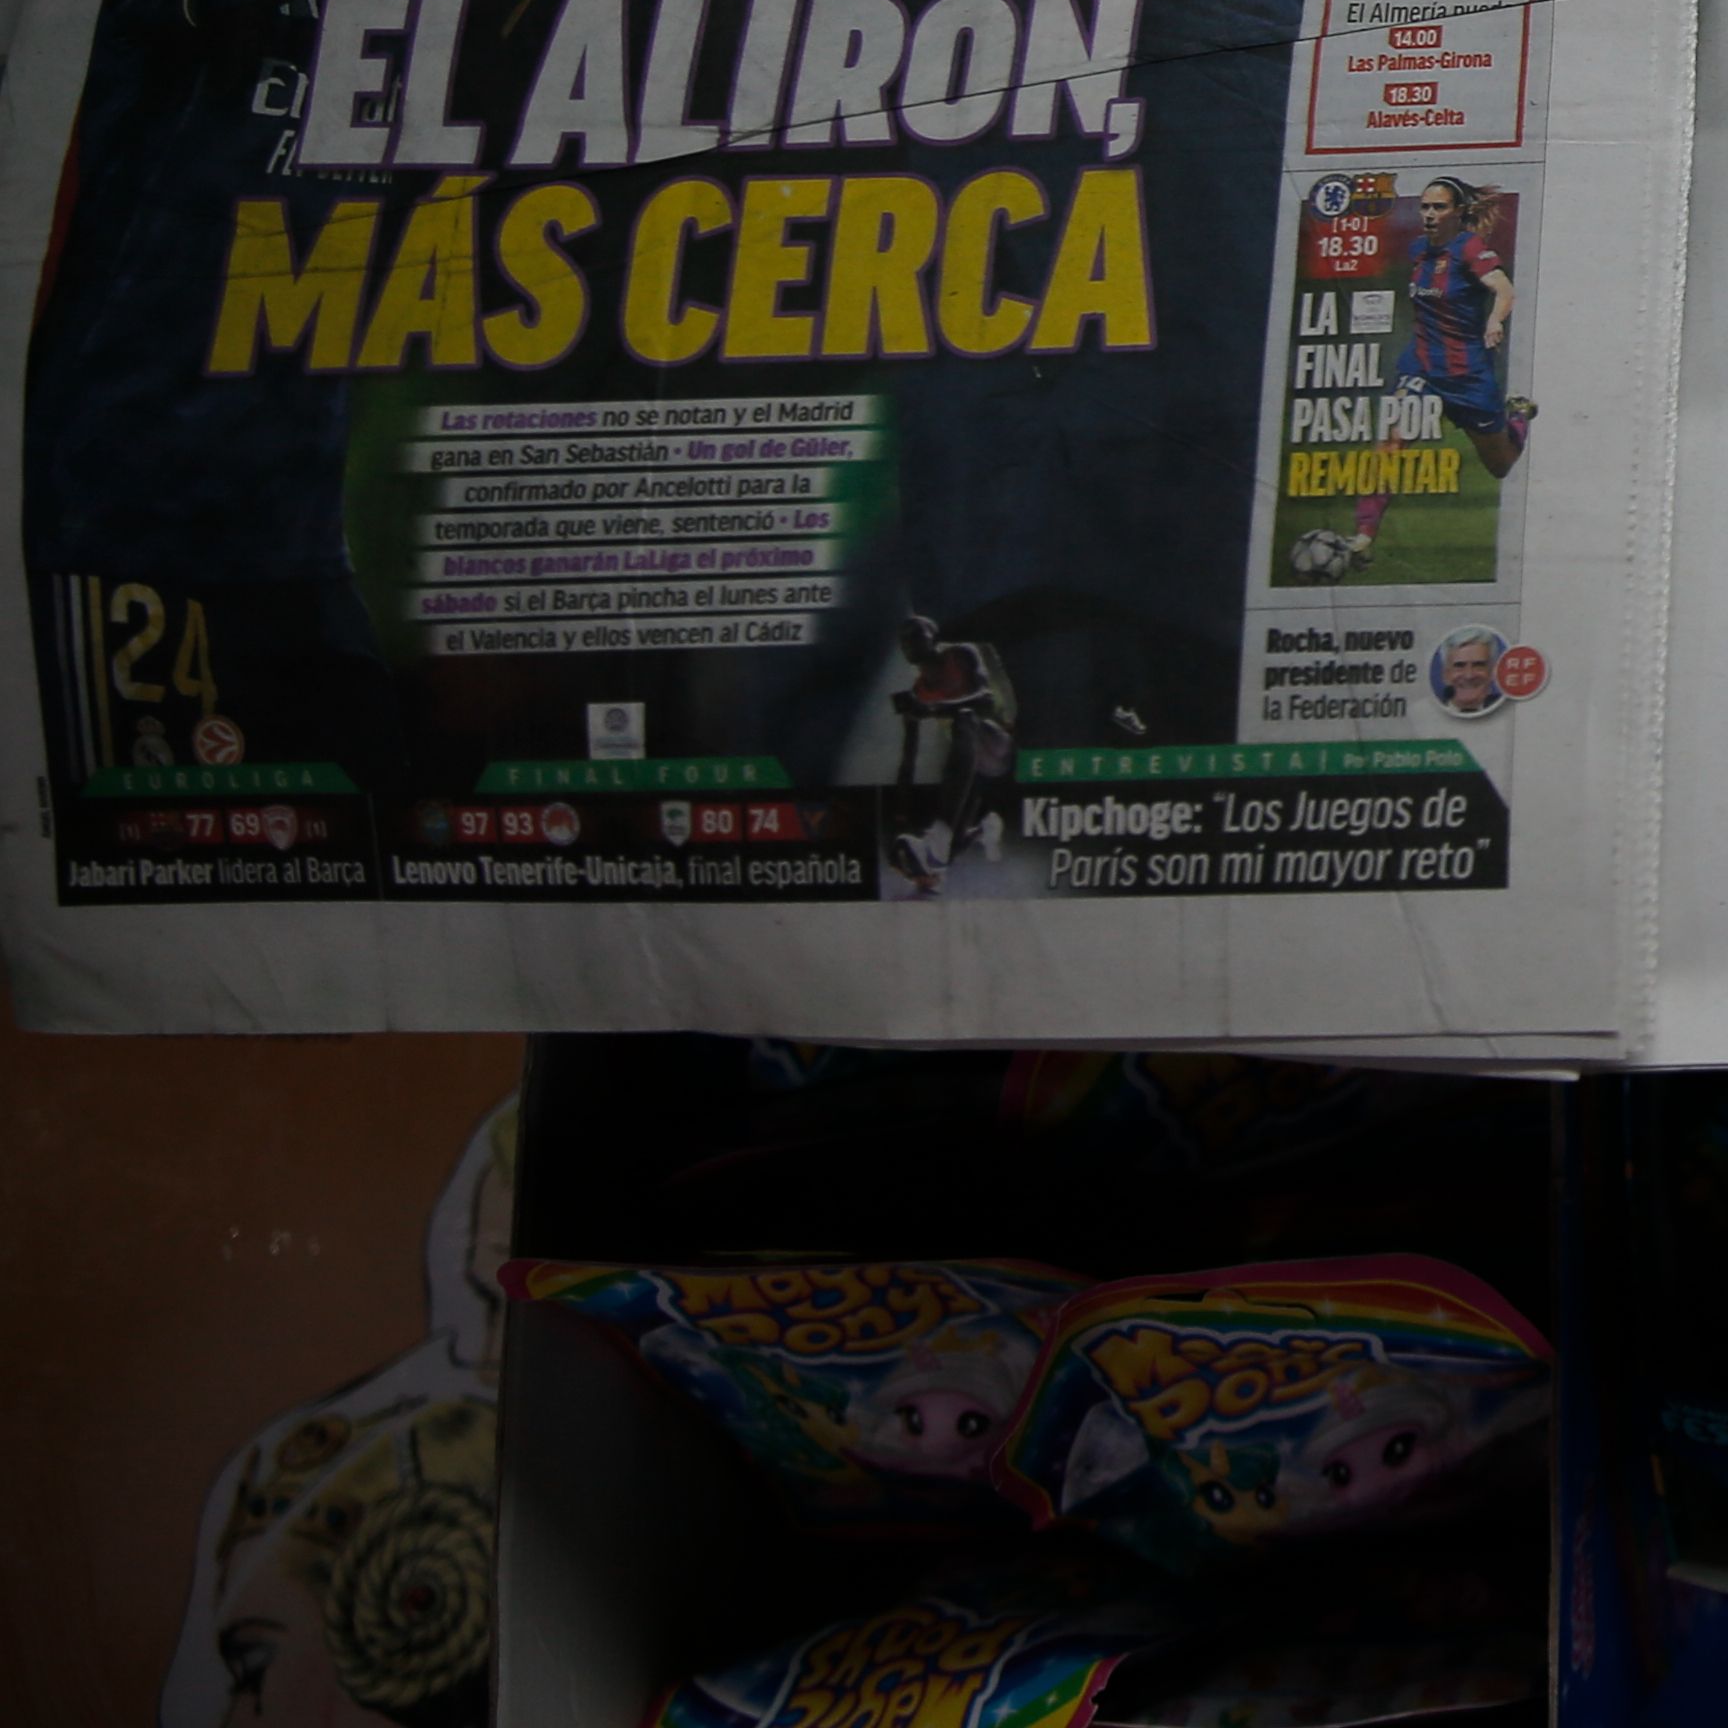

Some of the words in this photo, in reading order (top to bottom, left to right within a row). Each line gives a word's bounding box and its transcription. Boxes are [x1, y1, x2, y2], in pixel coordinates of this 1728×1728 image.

[205, 173, 600, 374] MÁS
[621, 166, 1155, 367] CERCA
[1318, 236, 1378, 257] 18.30
[1299, 291, 1338, 337] LA
[1296, 342, 1384, 389] FINAL
[1291, 397, 1372, 444] PASA
[1378, 394, 1444, 441] POR
[1287, 448, 1461, 497] REMONTAR
[1022, 795, 1203, 841] Kipchoge:
[1290, 791, 1412, 834] Juegos
[1421, 787, 1468, 829] de
[67, 859, 136, 889] Jabari
[139, 859, 213, 886] Parker
[218, 858, 278, 884] lidera
[284, 858, 301, 882] al
[306, 856, 365, 886] Barça
[1048, 846, 1138, 890] París
[1147, 852, 1210, 885] son
[1219, 845, 1264, 883] mi
[1273, 846, 1393, 888] mayor
[1400, 839, 1490, 881] reto”
